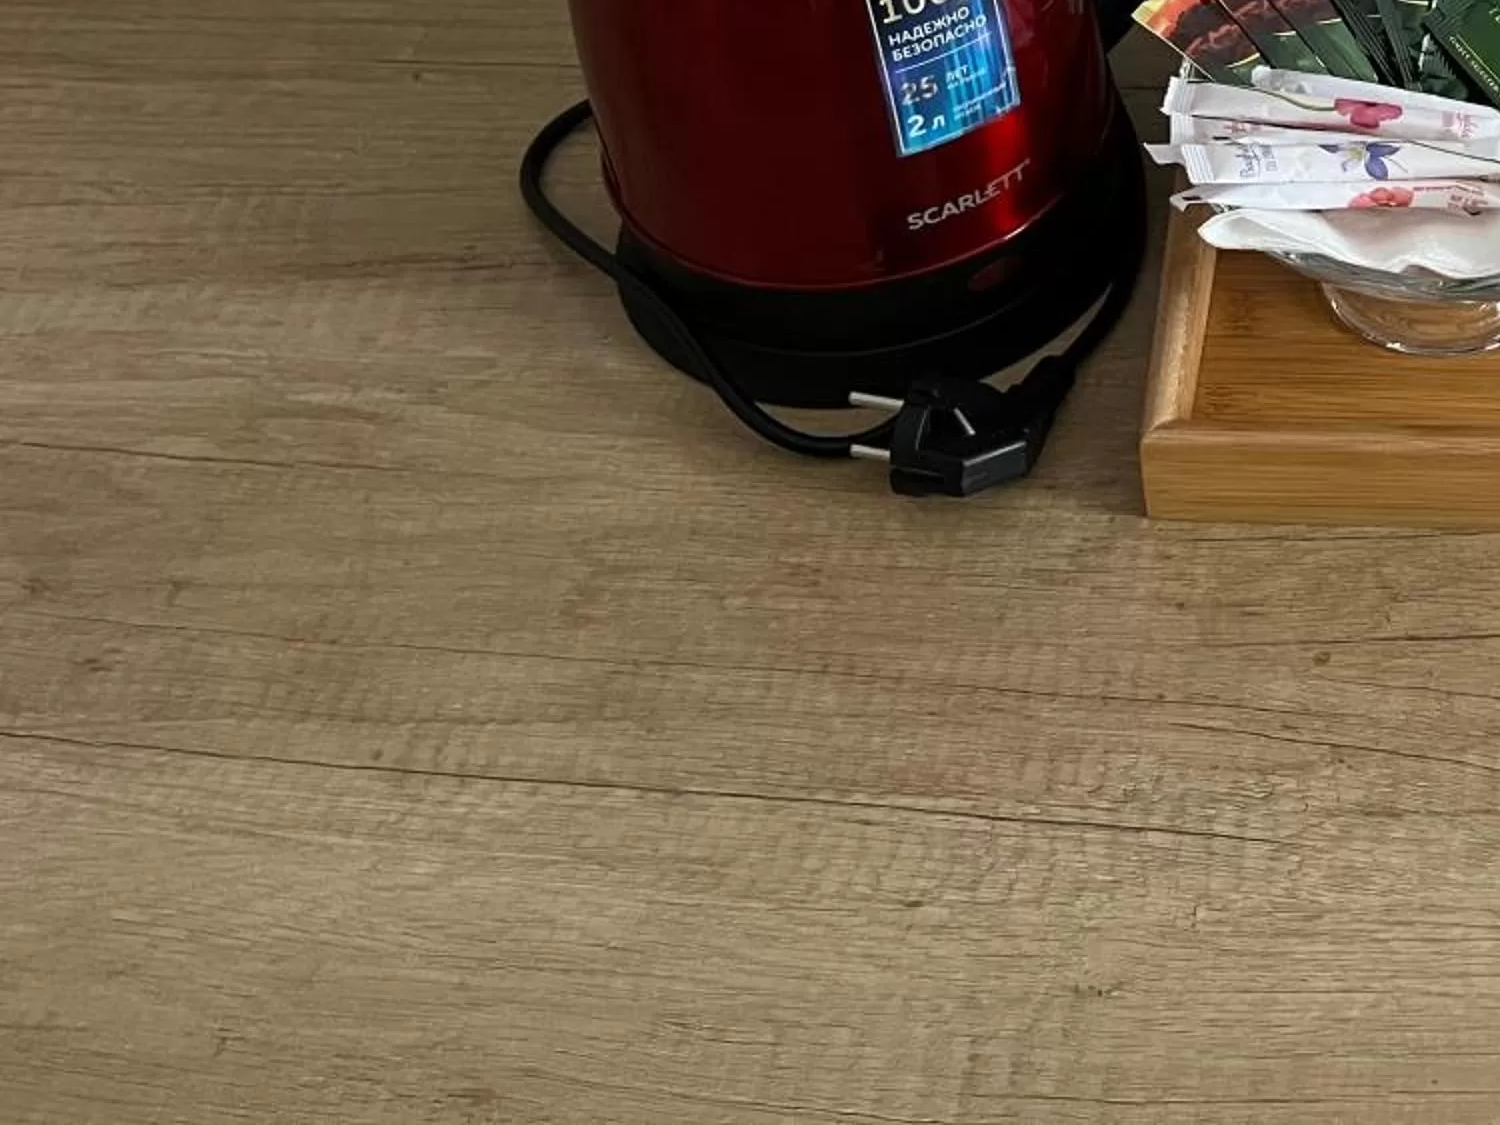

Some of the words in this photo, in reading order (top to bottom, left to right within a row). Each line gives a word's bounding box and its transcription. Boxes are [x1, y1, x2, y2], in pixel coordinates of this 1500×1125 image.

[888, 6, 970, 46] НАДЕЖНО
[891, 13, 987, 62] БЕЗОПАСНО
[907, 114, 927, 138] 2
[906, 165, 1027, 231] SCARLETT
